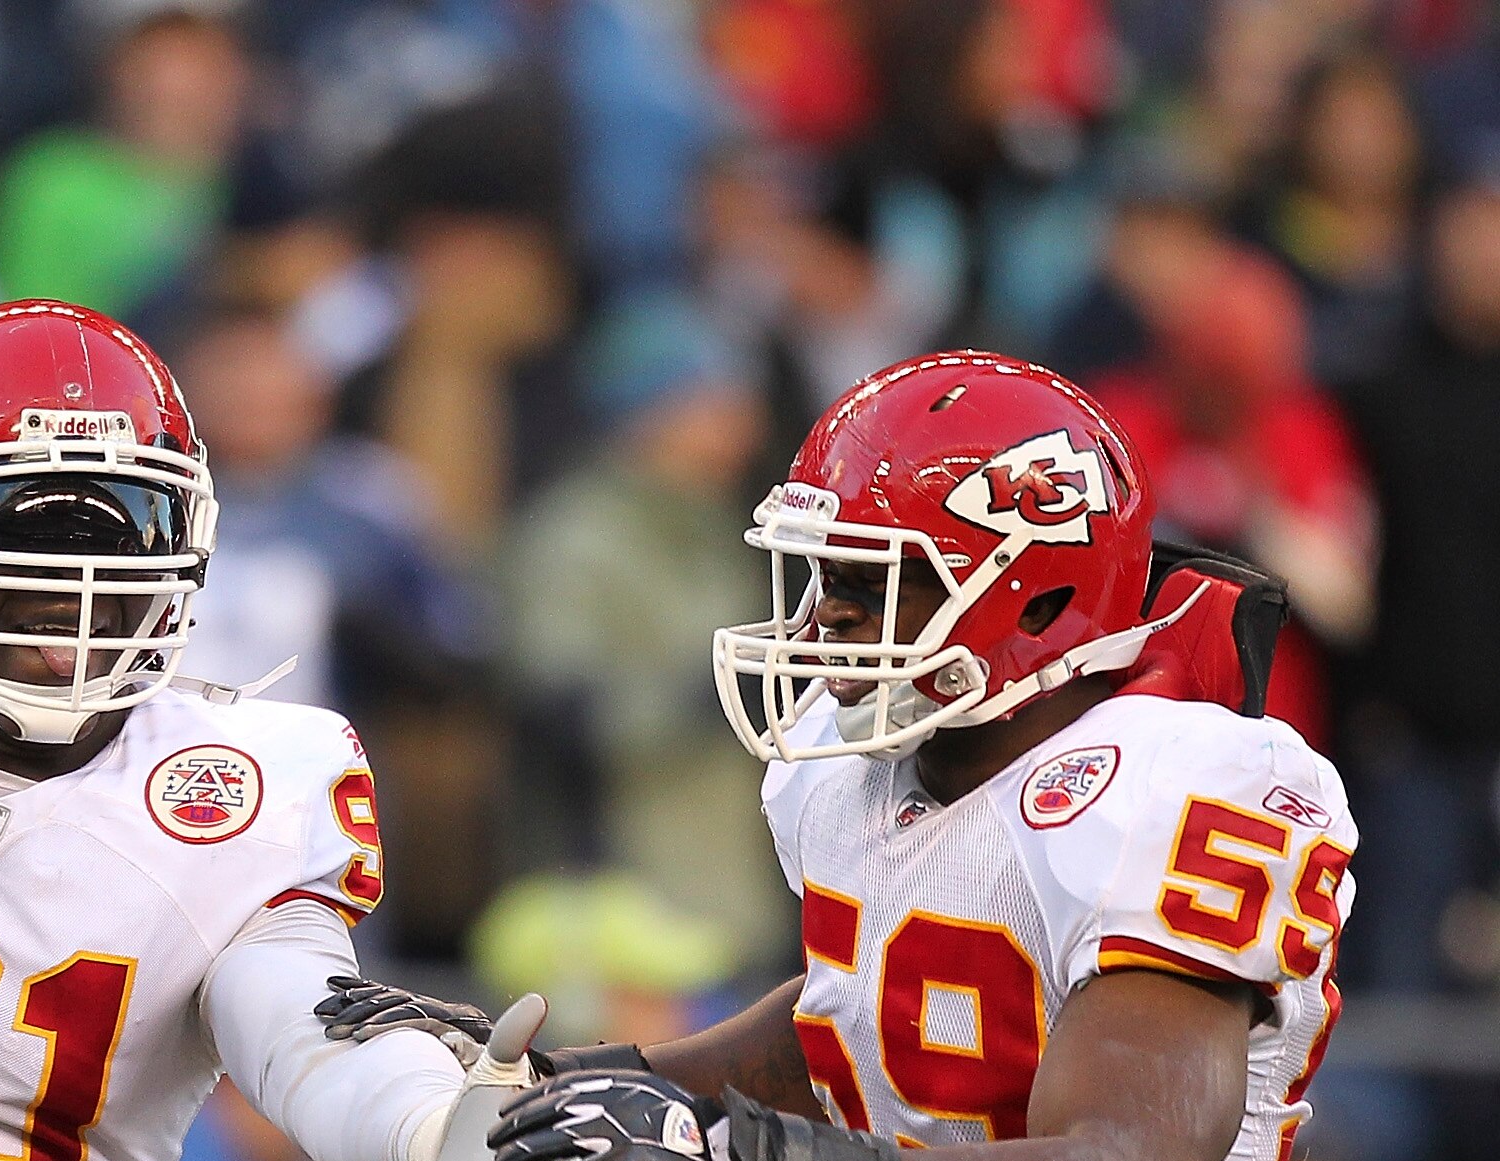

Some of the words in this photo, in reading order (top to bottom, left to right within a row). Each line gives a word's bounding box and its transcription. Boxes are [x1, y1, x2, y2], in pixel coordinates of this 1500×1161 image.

[45, 417, 109, 434] Riddell
[981, 457, 1091, 527] KC
[1154, 793, 1354, 982] 59
